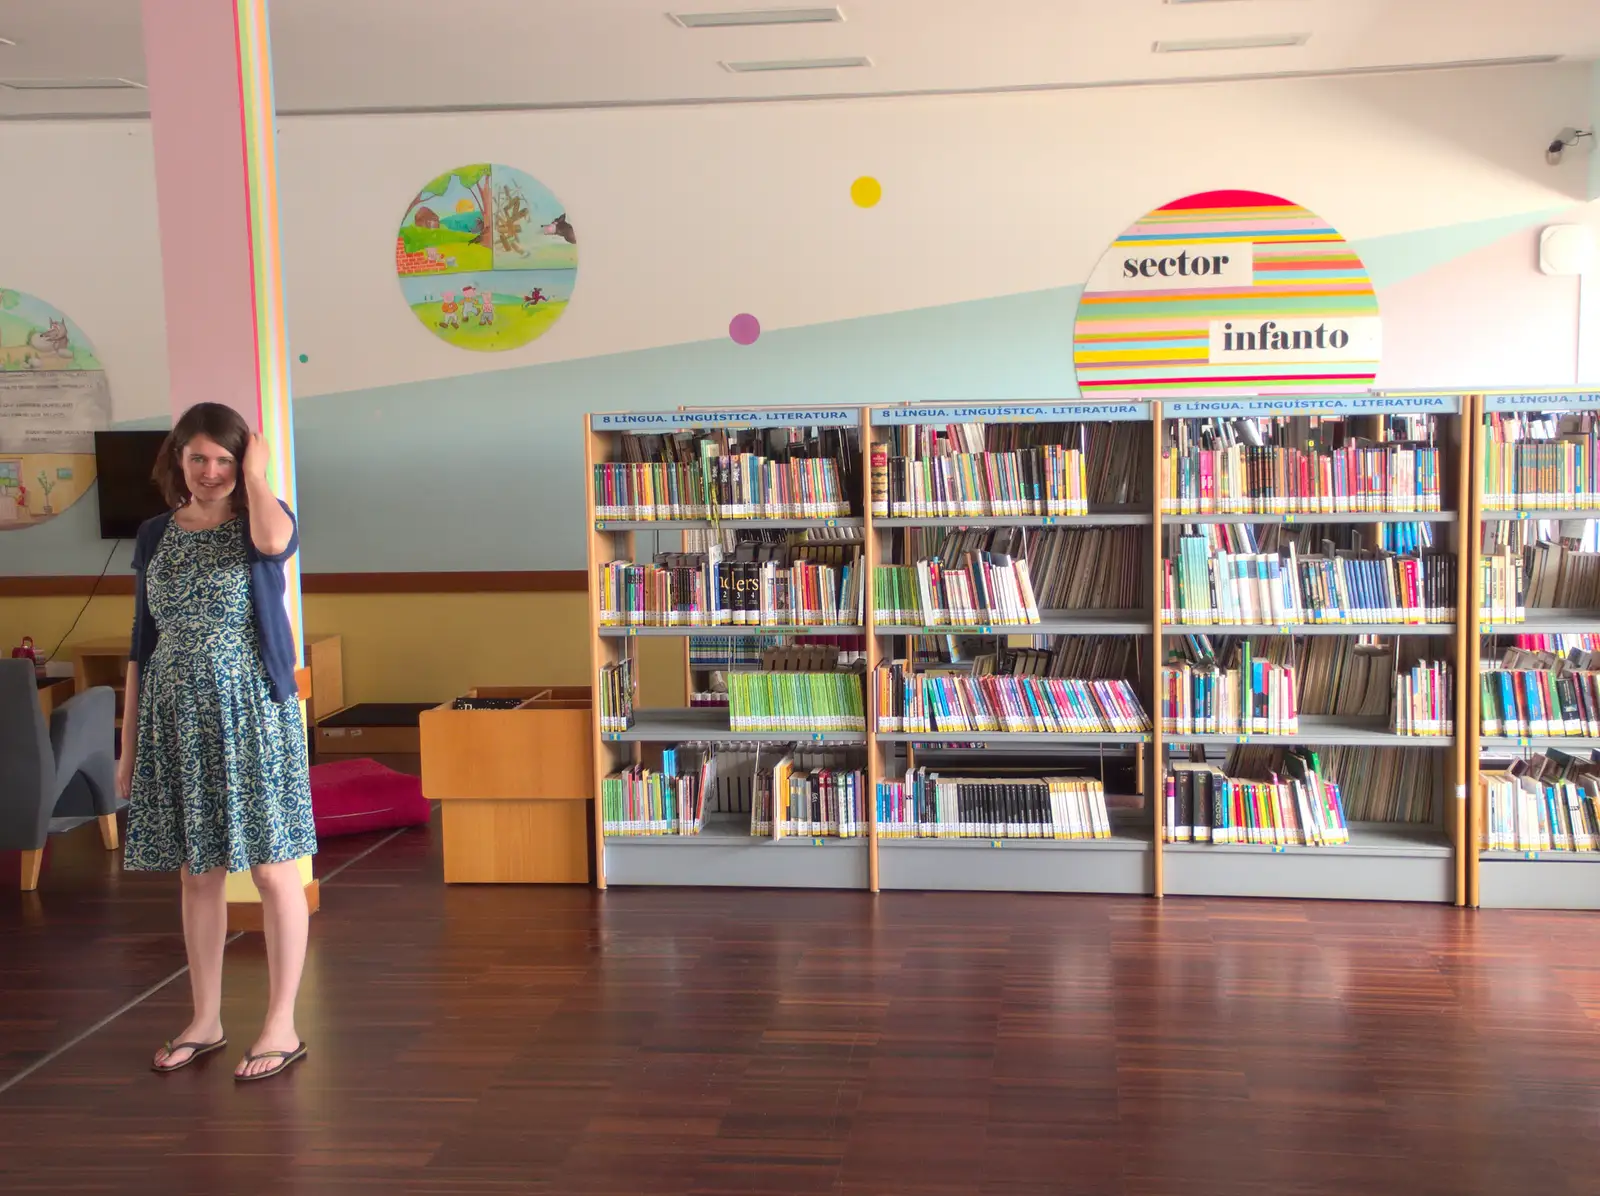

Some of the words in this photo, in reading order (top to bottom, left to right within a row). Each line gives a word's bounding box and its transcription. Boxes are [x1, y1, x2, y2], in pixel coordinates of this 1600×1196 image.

[1123, 249, 1229, 278] sector
[1222, 321, 1349, 351] infanto
[1187, 401, 1244, 410] LÍNGUA.
[1353, 398, 1443, 407] LITERATURA
[615, 414, 667, 423] LÍNGUA.
[766, 411, 847, 420] LITERATURA
[895, 408, 949, 417] LÍNGUA.
[1053, 406, 1137, 414] LITERATURA
